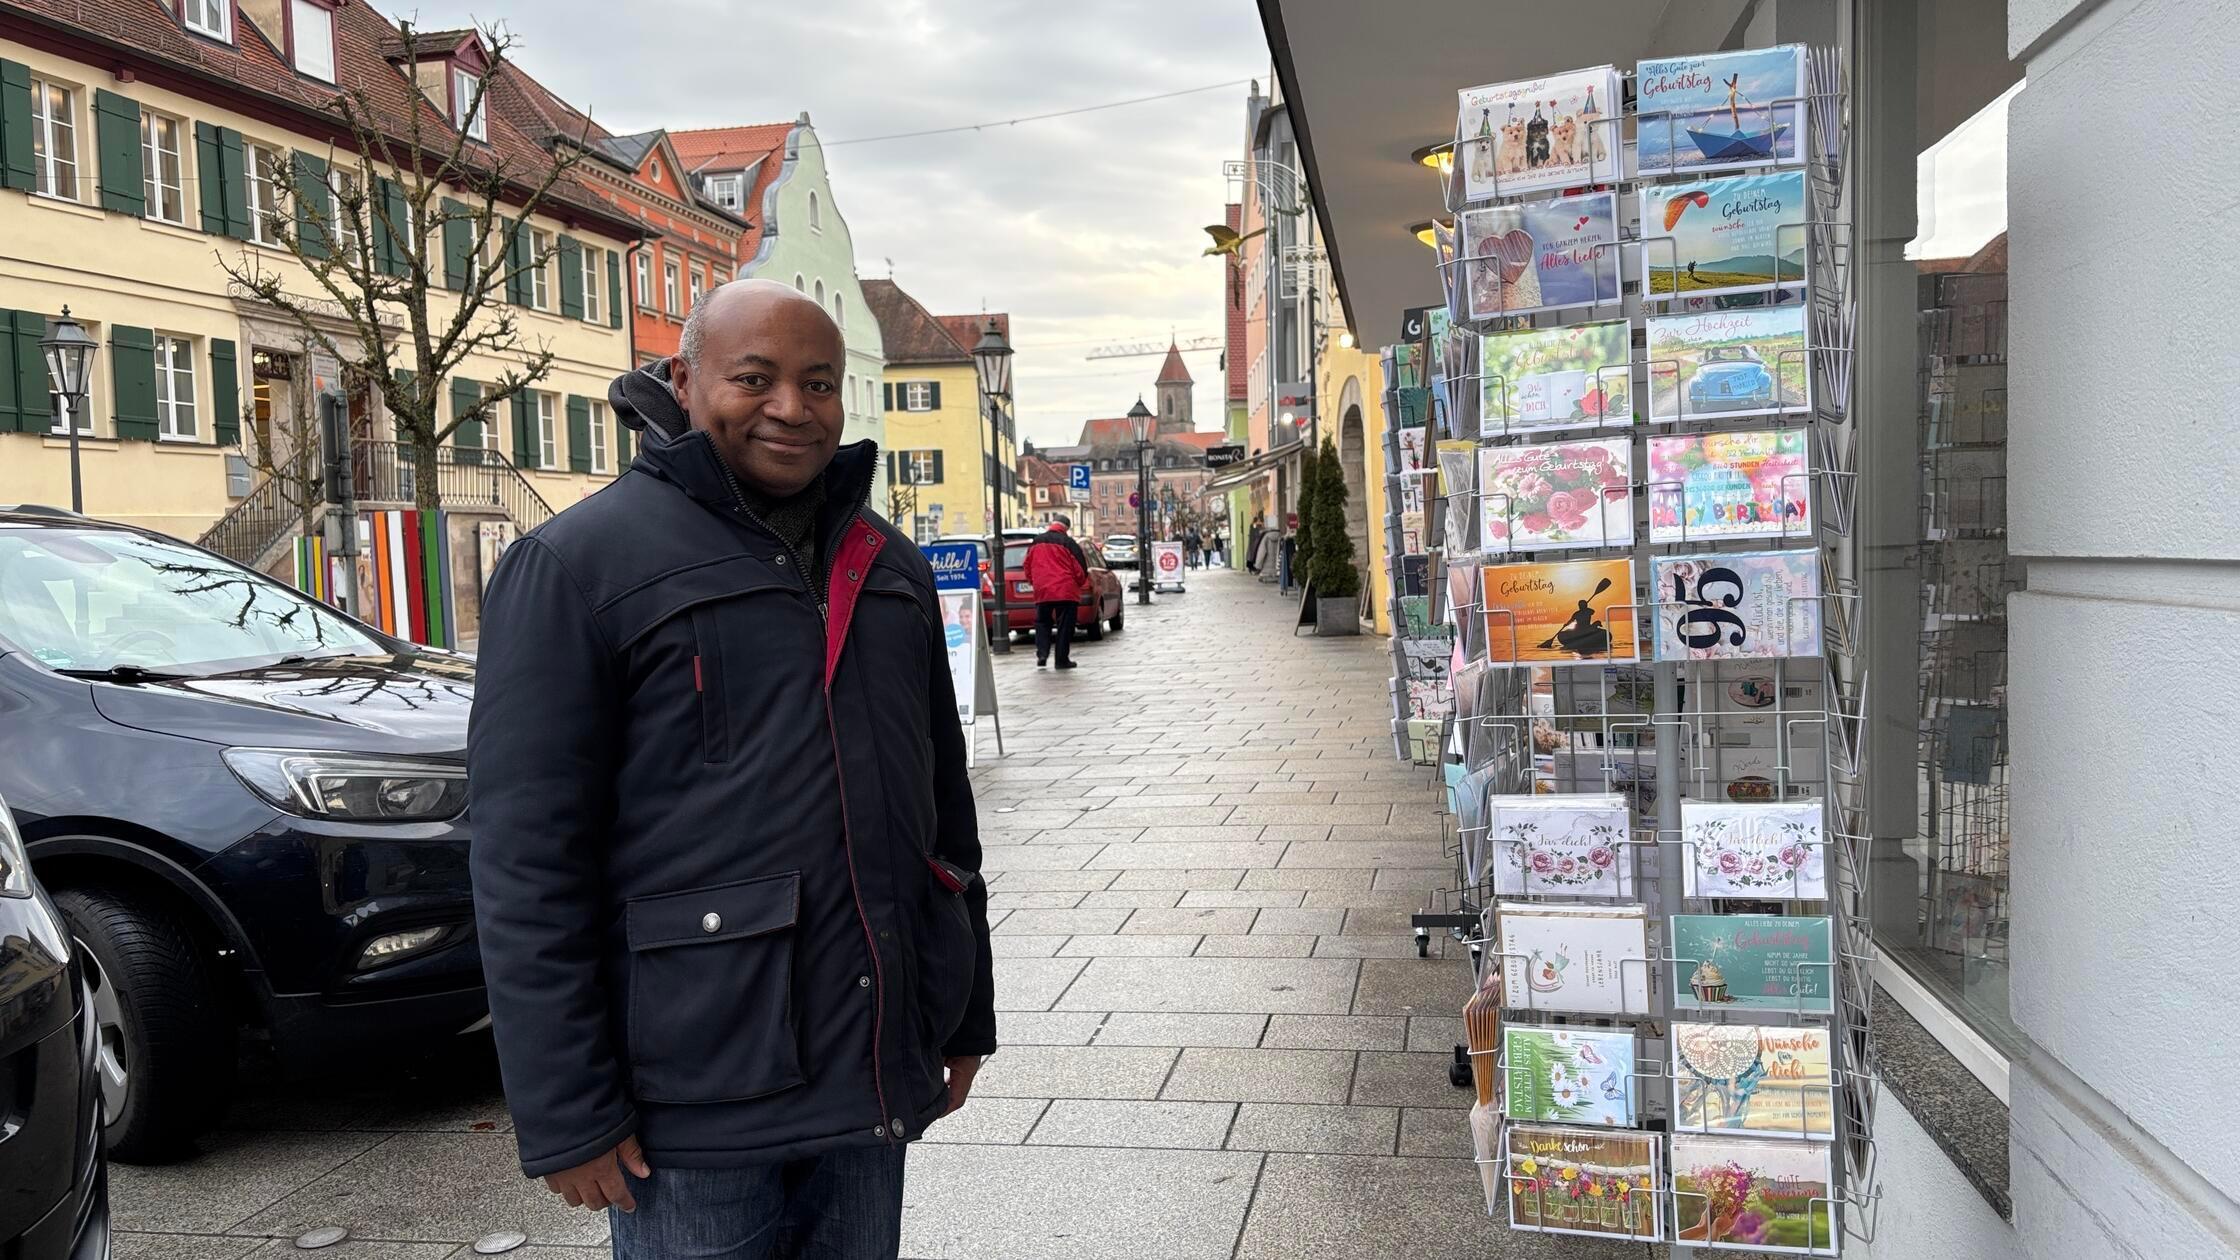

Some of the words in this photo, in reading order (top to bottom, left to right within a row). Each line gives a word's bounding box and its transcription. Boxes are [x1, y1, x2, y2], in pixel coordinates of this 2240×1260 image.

[1670, 61, 1687, 75] Gute
[1643, 73, 1712, 99] Geburtstag
[1722, 197, 1783, 220] Geburtstag
[1540, 251, 1569, 271] Alles
[1686, 313, 1753, 338] Hochzeit
[1513, 466, 1537, 474] zum
[1539, 456, 1605, 475] Geburtstag!
[1523, 451, 1551, 463] Gute
[1729, 460, 1760, 469] STUNDEN
[1073, 468, 1085, 487] P
[1712, 499, 1807, 525] BIRTHDAY
[936, 574, 949, 582] Seit
[1500, 578, 1555, 597] Geburtstag
[1751, 603, 1764, 626] Glück
[1775, 632, 1785, 646] und
[1536, 833, 1557, 847] Für
[1561, 833, 1592, 847] dich!
[1522, 1037, 1532, 1065] ALLES
[1759, 1031, 1820, 1053] Wünsche
[1777, 1051, 1793, 1066] für
[1523, 1094, 1533, 1113] ZUM
[1529, 1138, 1563, 1153] Danke
[1777, 1174, 1801, 1190] GUTE
